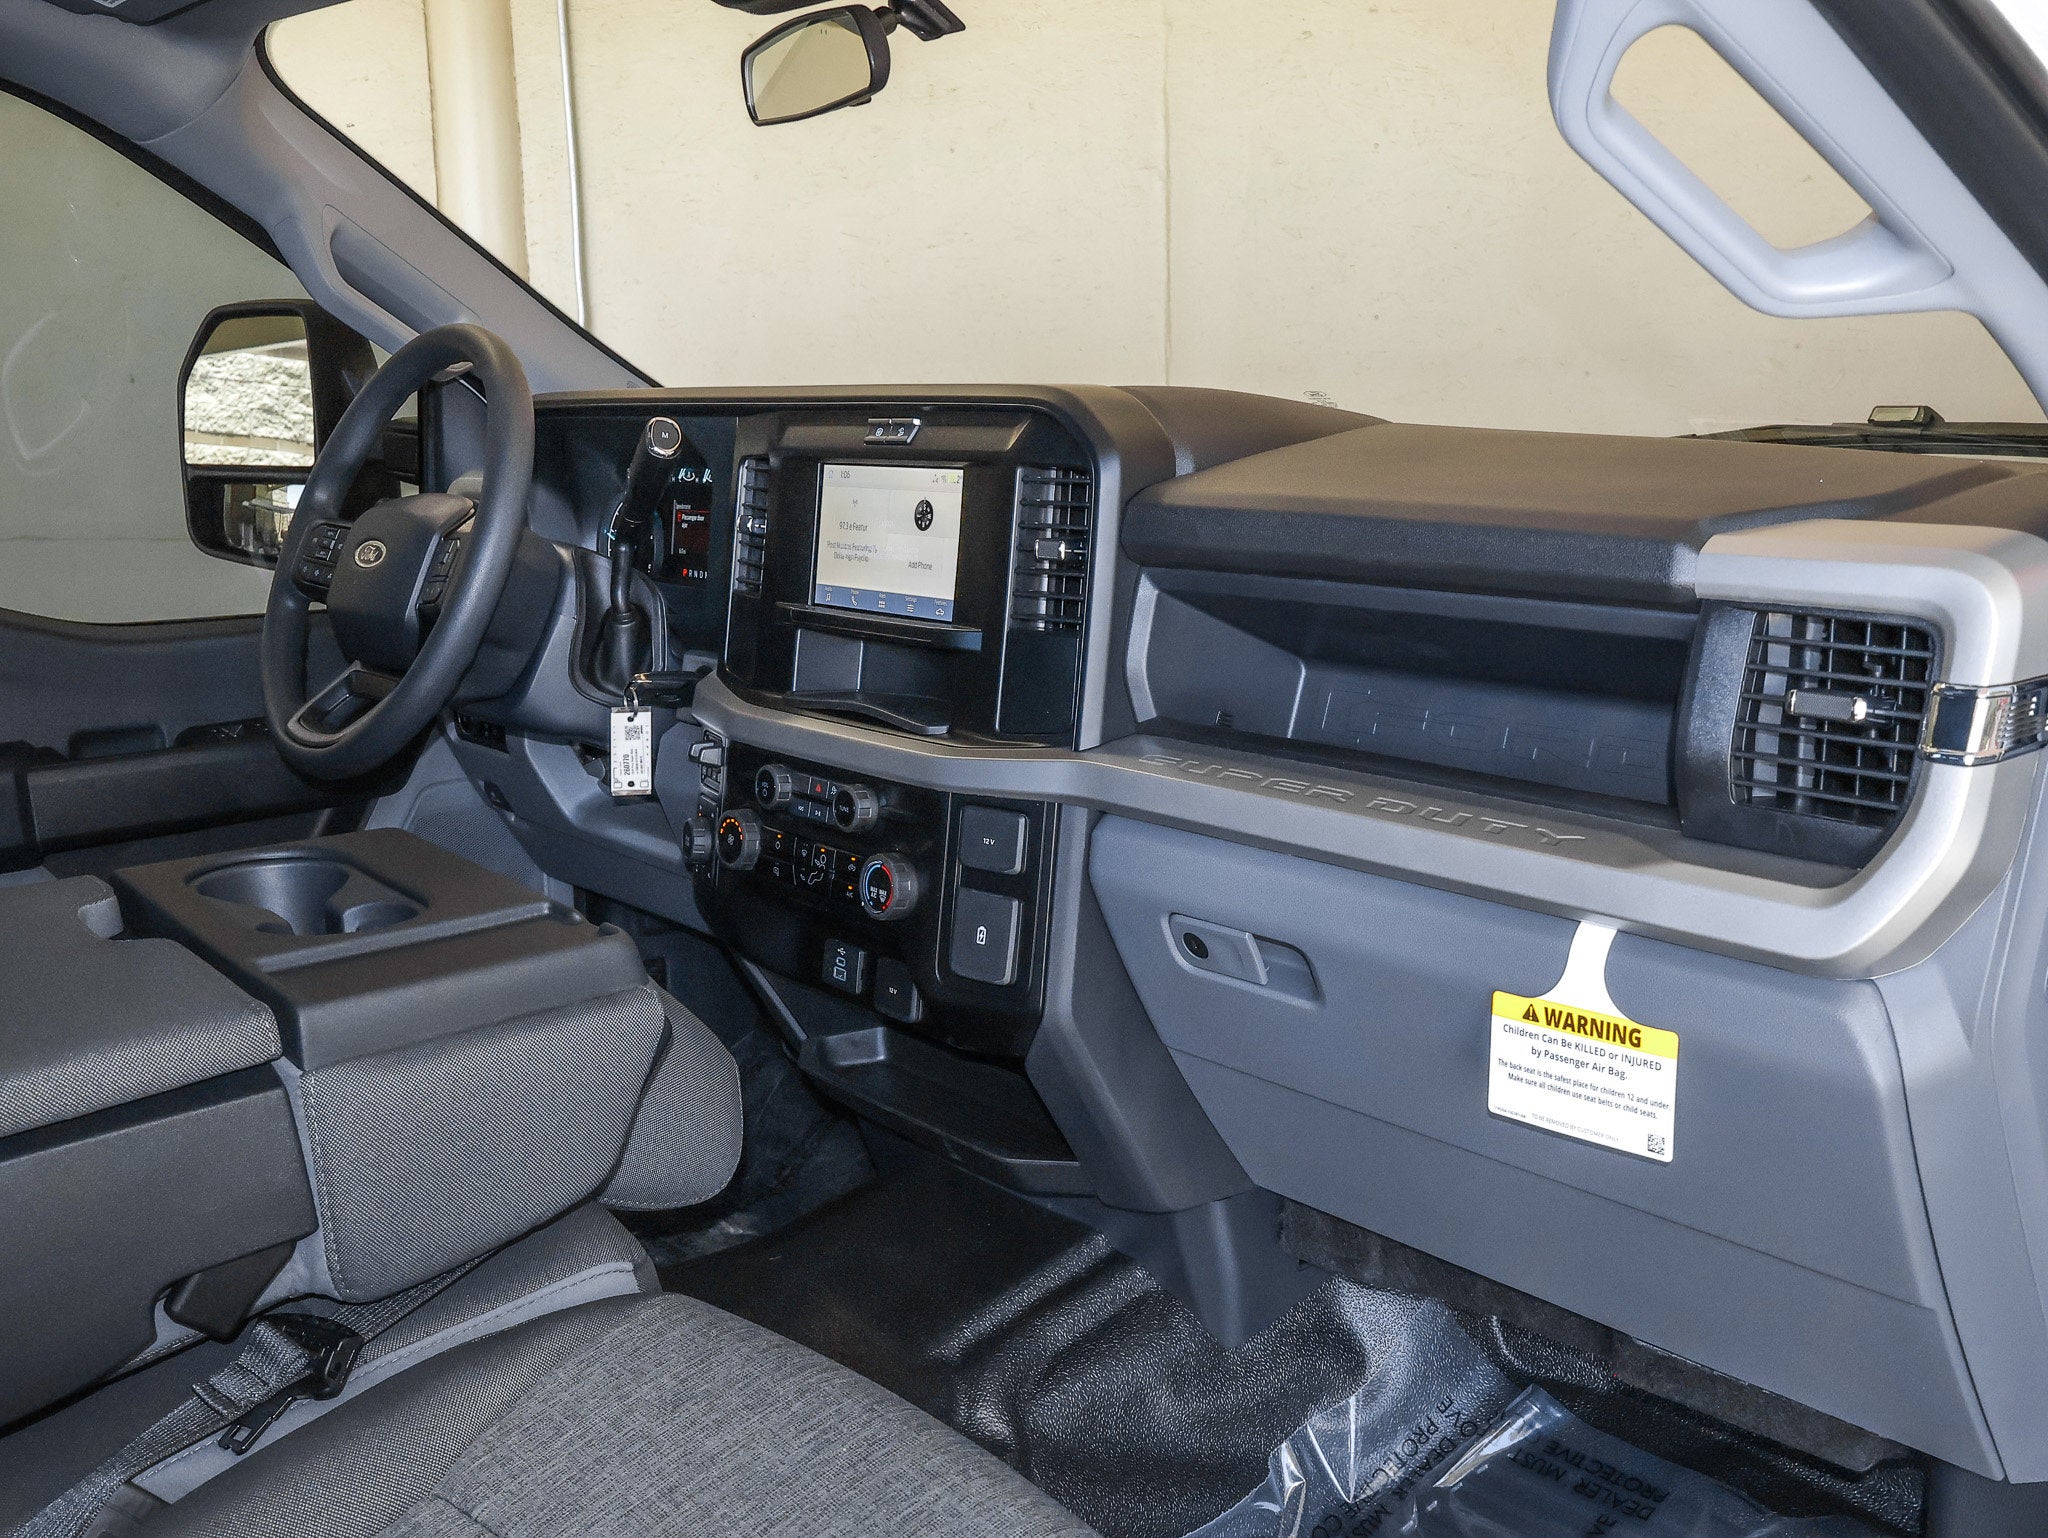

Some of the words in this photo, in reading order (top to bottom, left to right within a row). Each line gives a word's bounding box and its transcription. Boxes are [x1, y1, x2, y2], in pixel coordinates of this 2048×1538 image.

[661, 431, 669, 439] M
[907, 561, 918, 569] Add
[1138, 754, 1355, 802] SUPER
[1366, 796, 1587, 847] DUTY
[1503, 1024, 1540, 1041] Children
[1542, 1034, 1559, 1045] Can
[1561, 1038, 1572, 1048] Be
[1575, 1042, 1606, 1057] KILLED
[1608, 1052, 1619, 1060] or
[1621, 1053, 1662, 1071] INJURED
[1544, 1006, 1642, 1048] WARNING
[1498, 1058, 1508, 1067] The
[1509, 1061, 1522, 1071] back
[1523, 1066, 1536, 1075] seat
[1543, 1070, 1553, 1079] the
[1554, 1074, 1571, 1085] safest
[1572, 1079, 1588, 1089] place
[1590, 1082, 1599, 1091] for
[1600, 1086, 1625, 1098] children
[1627, 1093, 1634, 1101] 12
[1636, 1095, 1648, 1105] and
[1650, 1099, 1671, 1111] under.
[1531, 1046, 1542, 1059] by
[1544, 1049, 1590, 1069] Passenger
[1592, 1062, 1606, 1073] Air
[1608, 1066, 1628, 1081] Bag.
[1508, 1072, 1524, 1083] Make
[1525, 1078, 1537, 1087] sure
[1547, 1084, 1571, 1096] children
[1571, 1091, 1582, 1099] use
[1584, 1094, 1597, 1103] seat
[1598, 1096, 1613, 1108] belts
[1623, 1104, 1638, 1114] child
[1531, 1112, 1539, 1120] TO
[1339, 1417, 1439, 1518] PROTECTIVE
[1508, 1448, 1567, 1482] MUST
[1543, 1439, 1671, 1504] PROTECTIVE
[1574, 1477, 1657, 1522] DEALER
